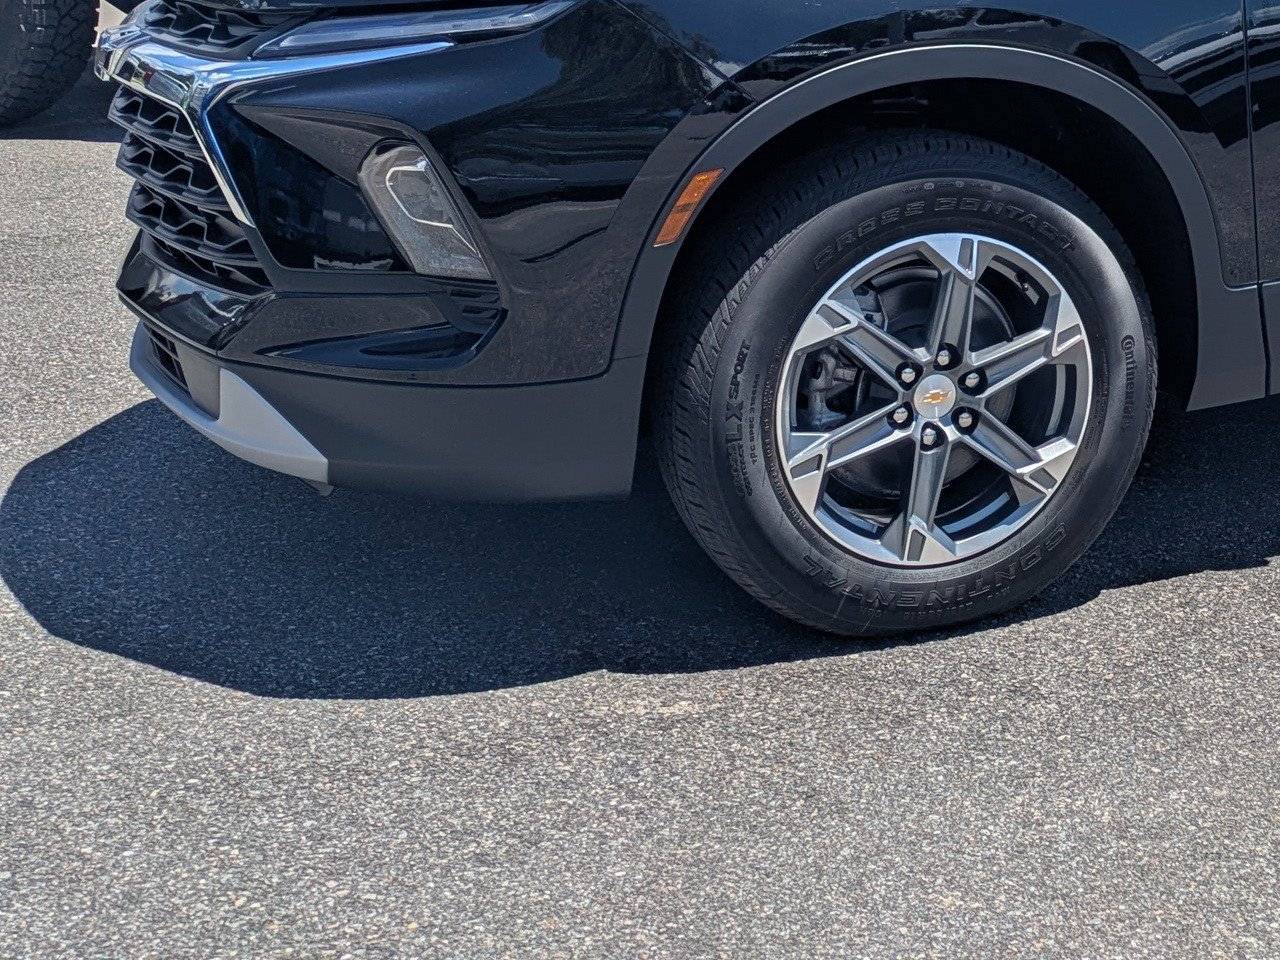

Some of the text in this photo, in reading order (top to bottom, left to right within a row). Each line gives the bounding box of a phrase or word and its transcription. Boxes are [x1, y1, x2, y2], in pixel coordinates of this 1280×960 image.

[728, 339, 751, 401] SPORT
[724, 400, 744, 444] LX
[803, 522, 1068, 609] CONTINENTAL
